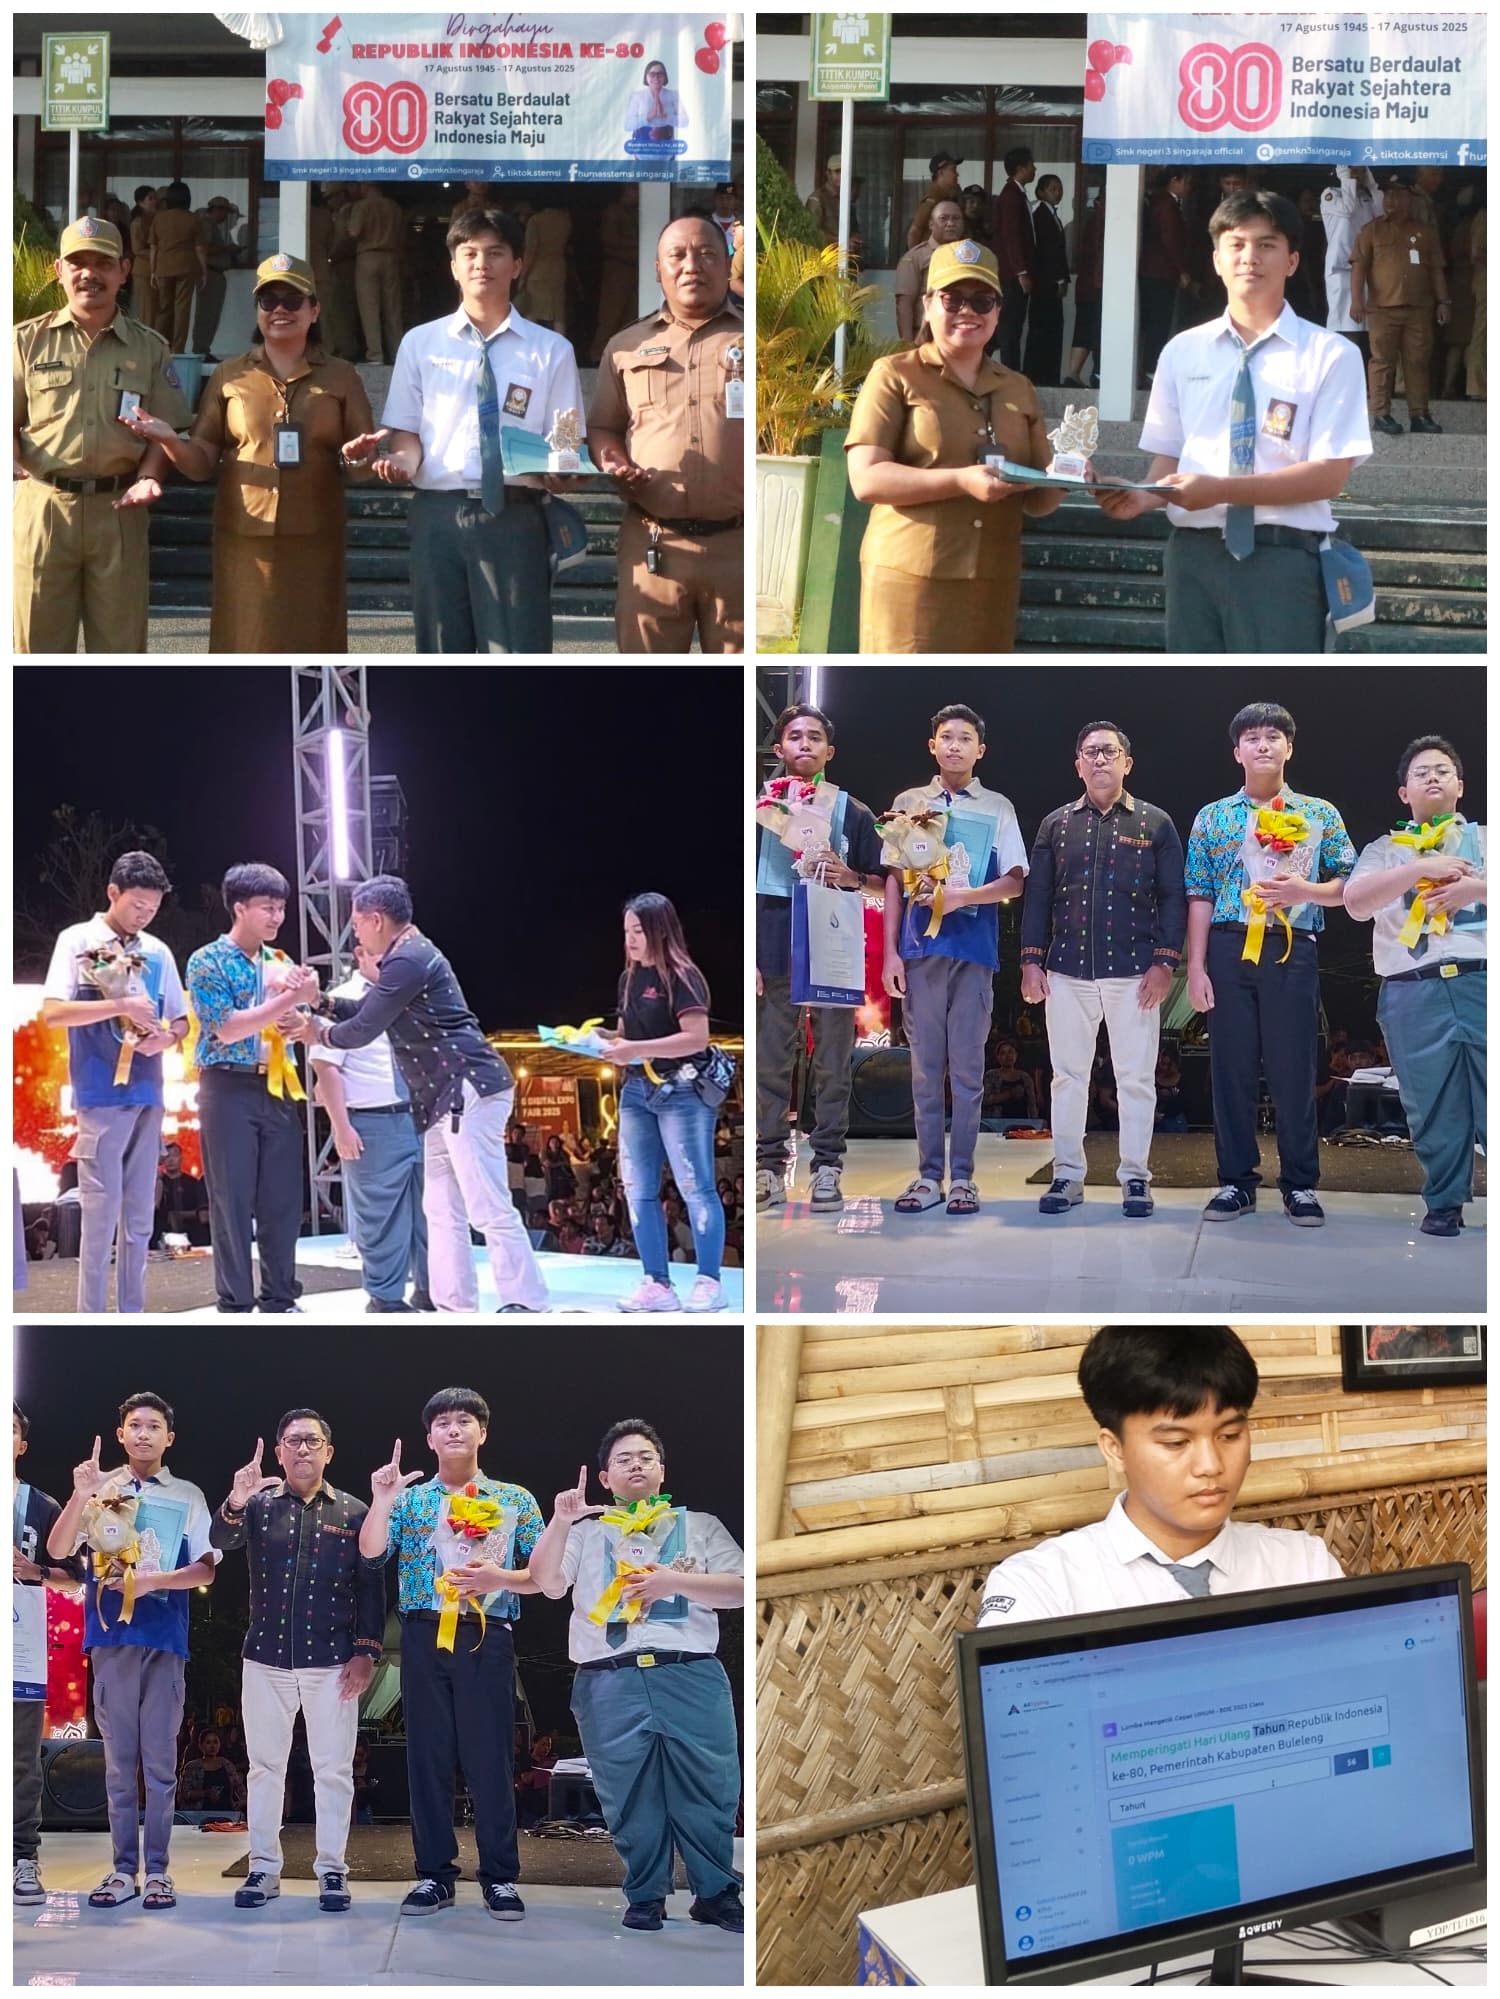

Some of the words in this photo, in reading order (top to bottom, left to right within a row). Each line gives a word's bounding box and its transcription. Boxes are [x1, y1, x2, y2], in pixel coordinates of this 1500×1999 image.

[1280, 22, 1293, 32] 17
[1295, 22, 1340, 34] Agustus
[1343, 22, 1368, 32] 1945
[1378, 22, 1391, 32] 17
[1393, 22, 1439, 34] Agustus
[1442, 22, 1468, 32] 2025
[352, 43, 454, 59] REPUBLIK
[459, 42, 574, 59] INDONESIA
[580, 42, 645, 59] KE-80
[424, 64, 435, 73] 17
[436, 64, 473, 74] Agustus
[476, 64, 496, 73] 1945
[503, 64, 514, 73] 17
[515, 64, 552, 74] Agustus
[554, 64, 575, 73] 2025
[1292, 56, 1365, 73] Bersatu
[1370, 56, 1462, 73] Berdaulat
[820, 69, 844, 80] TITIK
[845, 70, 881, 81] KUMPUL
[1177, 42, 1283, 132] 80
[1291, 79, 1355, 99] Rakyat
[1360, 78, 1451, 100] Sejahtera
[434, 92, 493, 107] Bersatu
[497, 91, 571, 107] Berdaulat
[342, 80, 428, 154] 80
[434, 111, 486, 128] Rakyat
[489, 111, 563, 129] Sejahtera
[1290, 102, 1380, 119] Indonesia
[1386, 102, 1429, 123] Maju
[434, 130, 507, 144] Indonesia
[510, 130, 545, 148] Maju
[1136, 147, 1164, 158] negeri
[1172, 147, 1213, 158] singaraja
[1214, 147, 1243, 156] official
[1380, 149, 1448, 160] tiktok.stemsi
[373, 166, 397, 175] official
[507, 167, 562, 178] tiktok.stemsi
[1111, 1739, 1192, 1763] Memperingati
[1194, 1733, 1217, 1748] Hari
[1219, 1729, 1251, 1743] Ulang
[1253, 1722, 1286, 1737] Tahun
[1288, 1712, 1333, 1731] Republik
[1335, 1704, 1383, 1721] Indonesia
[1112, 1766, 1148, 1783] ke-80,
[1150, 1755, 1215, 1775] Pemerintah
[1217, 1742, 1276, 1762] Kabupaten
[1278, 1734, 1324, 1751] Buleleng
[1120, 1800, 1145, 1813] Tahun
[1136, 1849, 1166, 1864] WPM
[1246, 1919, 1283, 1936] QWERTY
